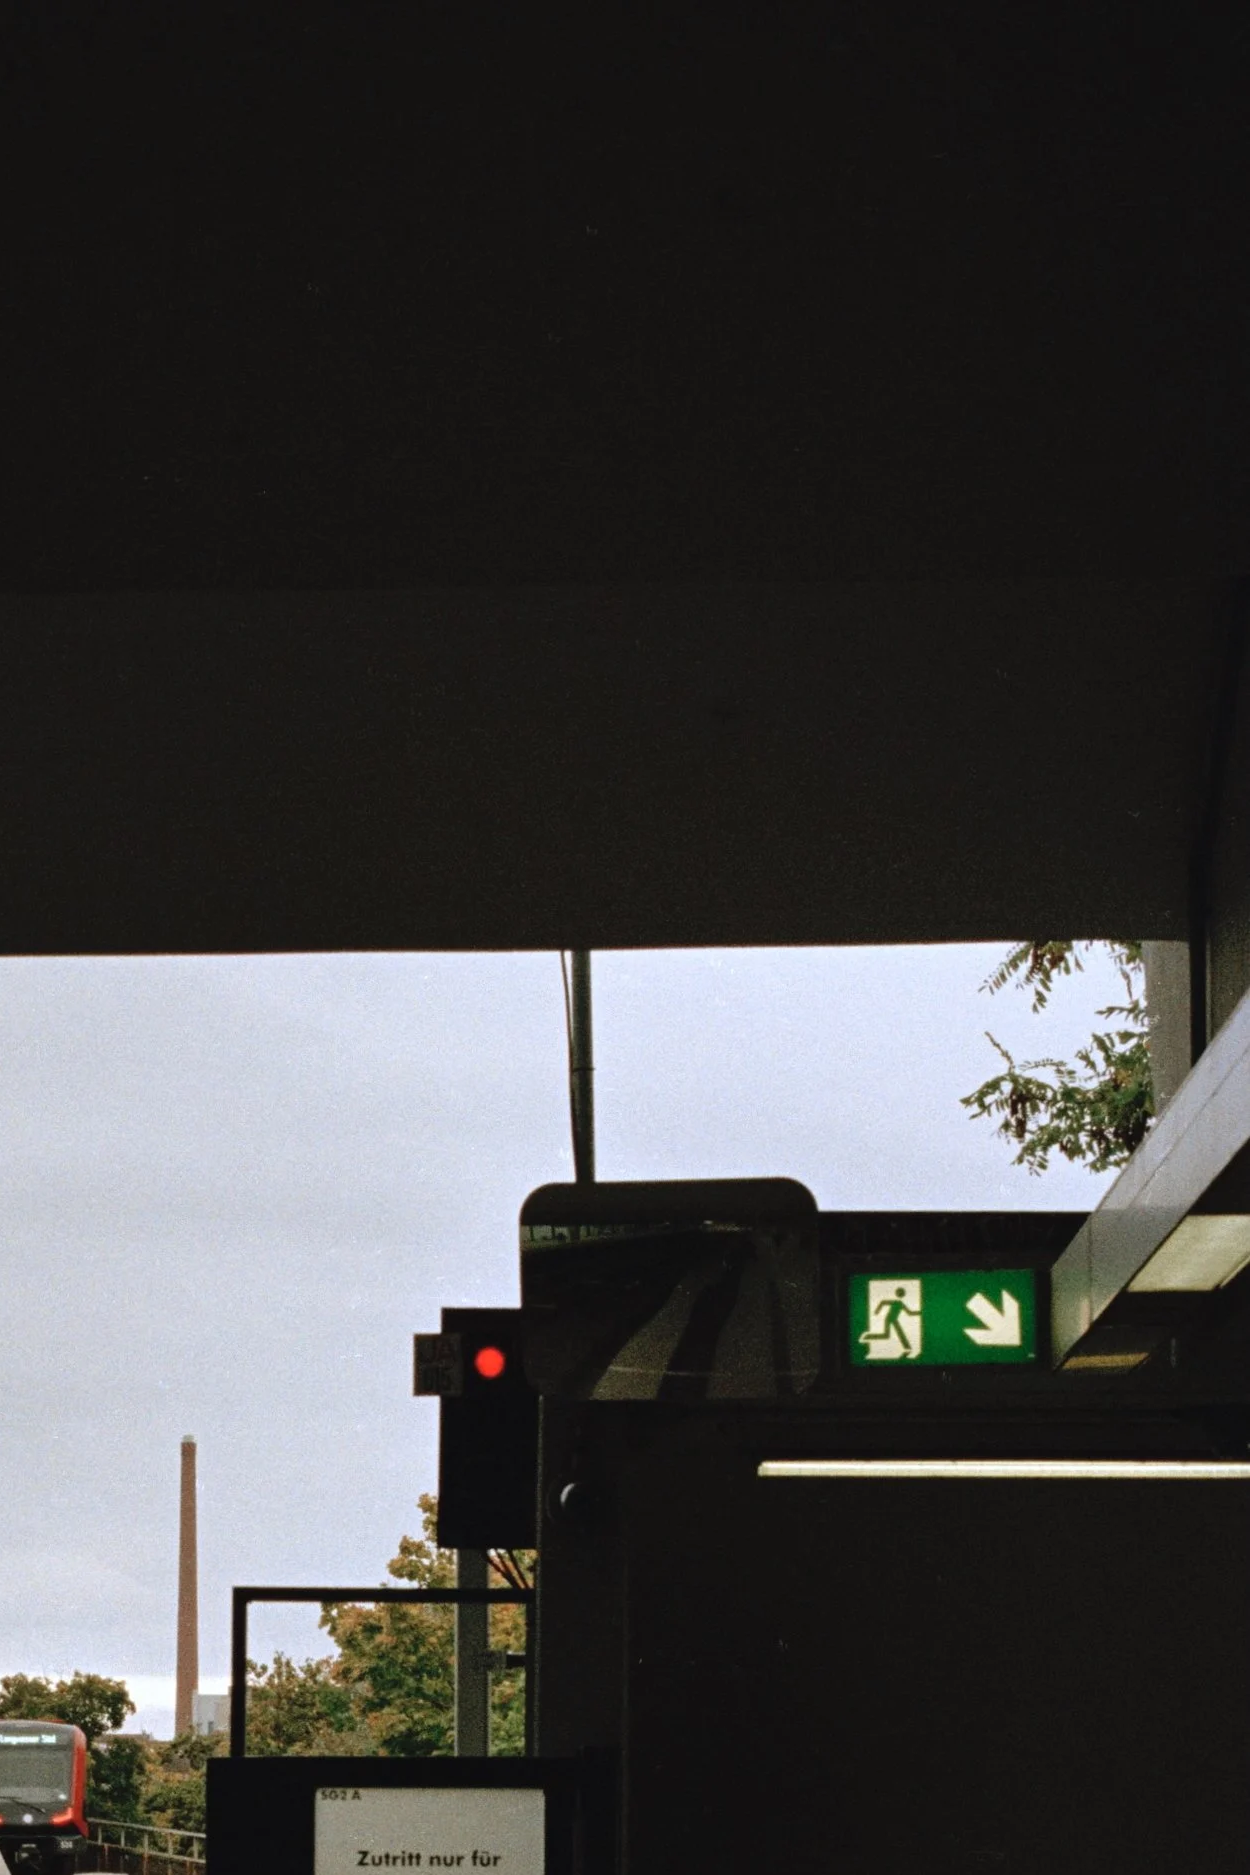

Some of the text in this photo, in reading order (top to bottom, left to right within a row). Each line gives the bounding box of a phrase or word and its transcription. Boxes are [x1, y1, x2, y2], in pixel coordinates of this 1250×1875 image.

[357, 1850, 502, 1867] Zutritt nur für
